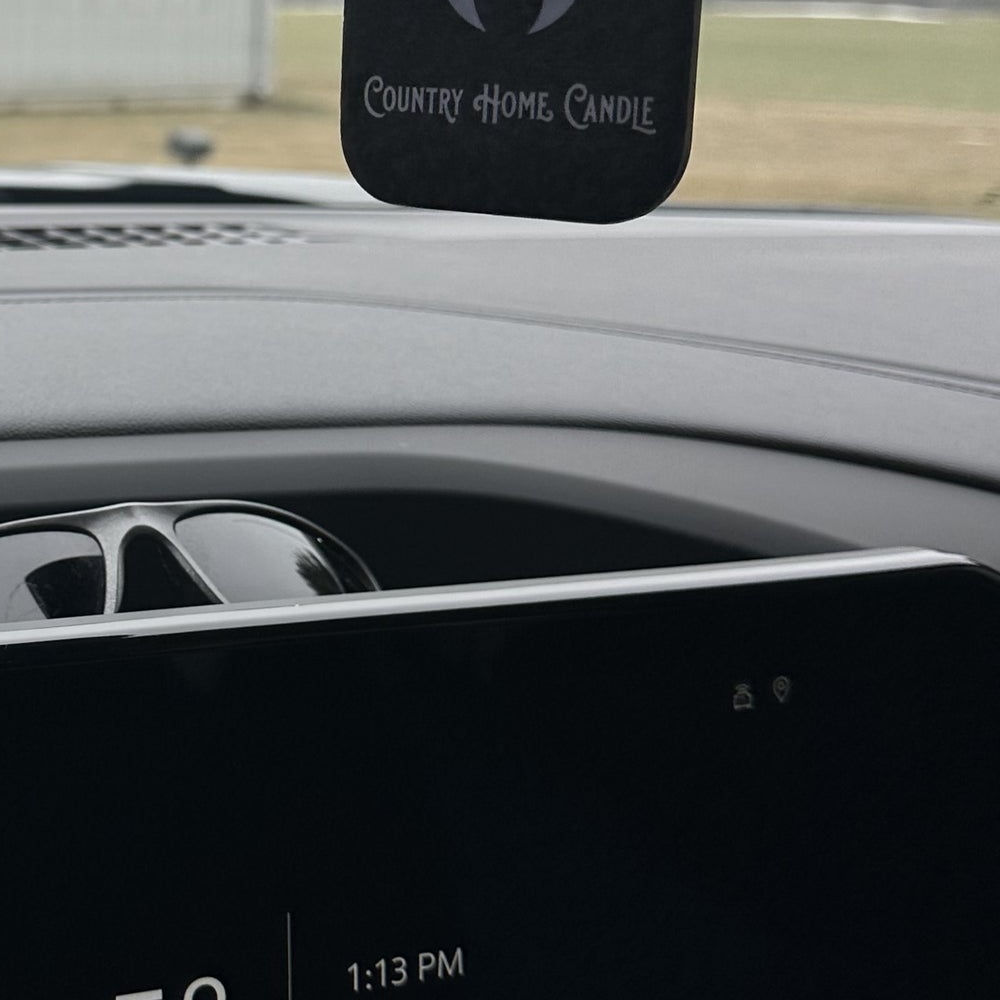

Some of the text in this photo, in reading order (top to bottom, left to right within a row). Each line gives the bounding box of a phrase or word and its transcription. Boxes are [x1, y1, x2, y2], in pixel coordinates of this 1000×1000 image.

[364, 75, 657, 135] COUNTRY HOME CANDLE
[347, 947, 465, 992] 1:13 PM
